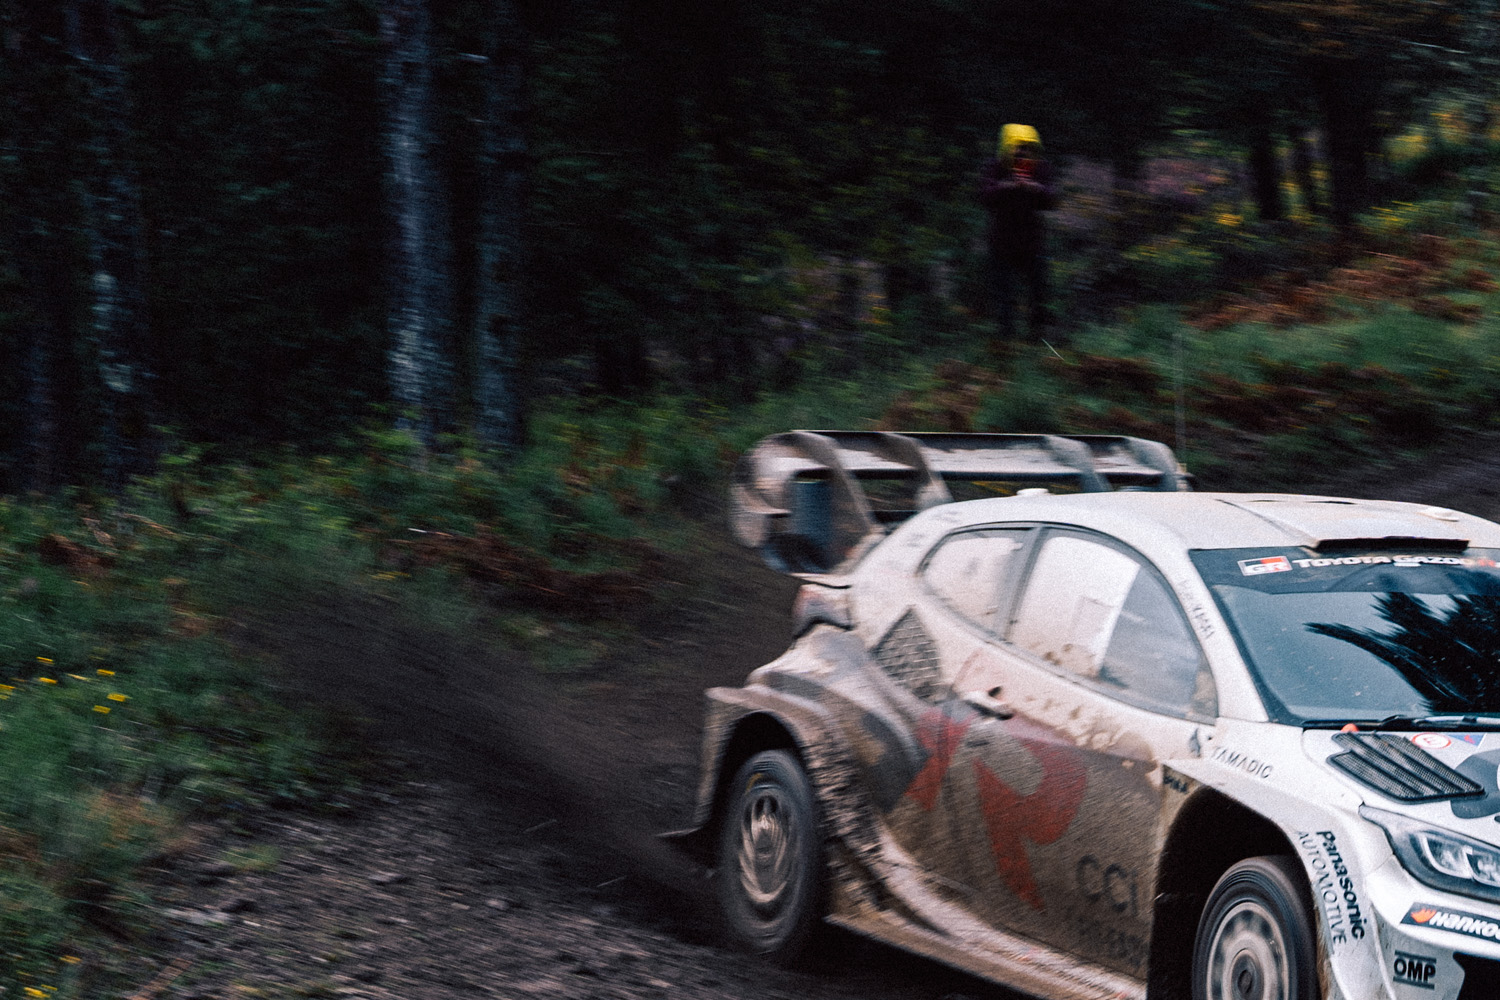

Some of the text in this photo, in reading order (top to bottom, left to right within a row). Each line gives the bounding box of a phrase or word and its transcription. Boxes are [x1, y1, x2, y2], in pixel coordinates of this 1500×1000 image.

[1242, 560, 1291, 575] GR
[1292, 556, 1391, 568] TOYOTA
[1211, 745, 1273, 779] TAMADIC
[1296, 832, 1347, 944] AUTOMOTIVE
[1316, 831, 1368, 939] Panasonic
[1393, 957, 1437, 983] OMP
